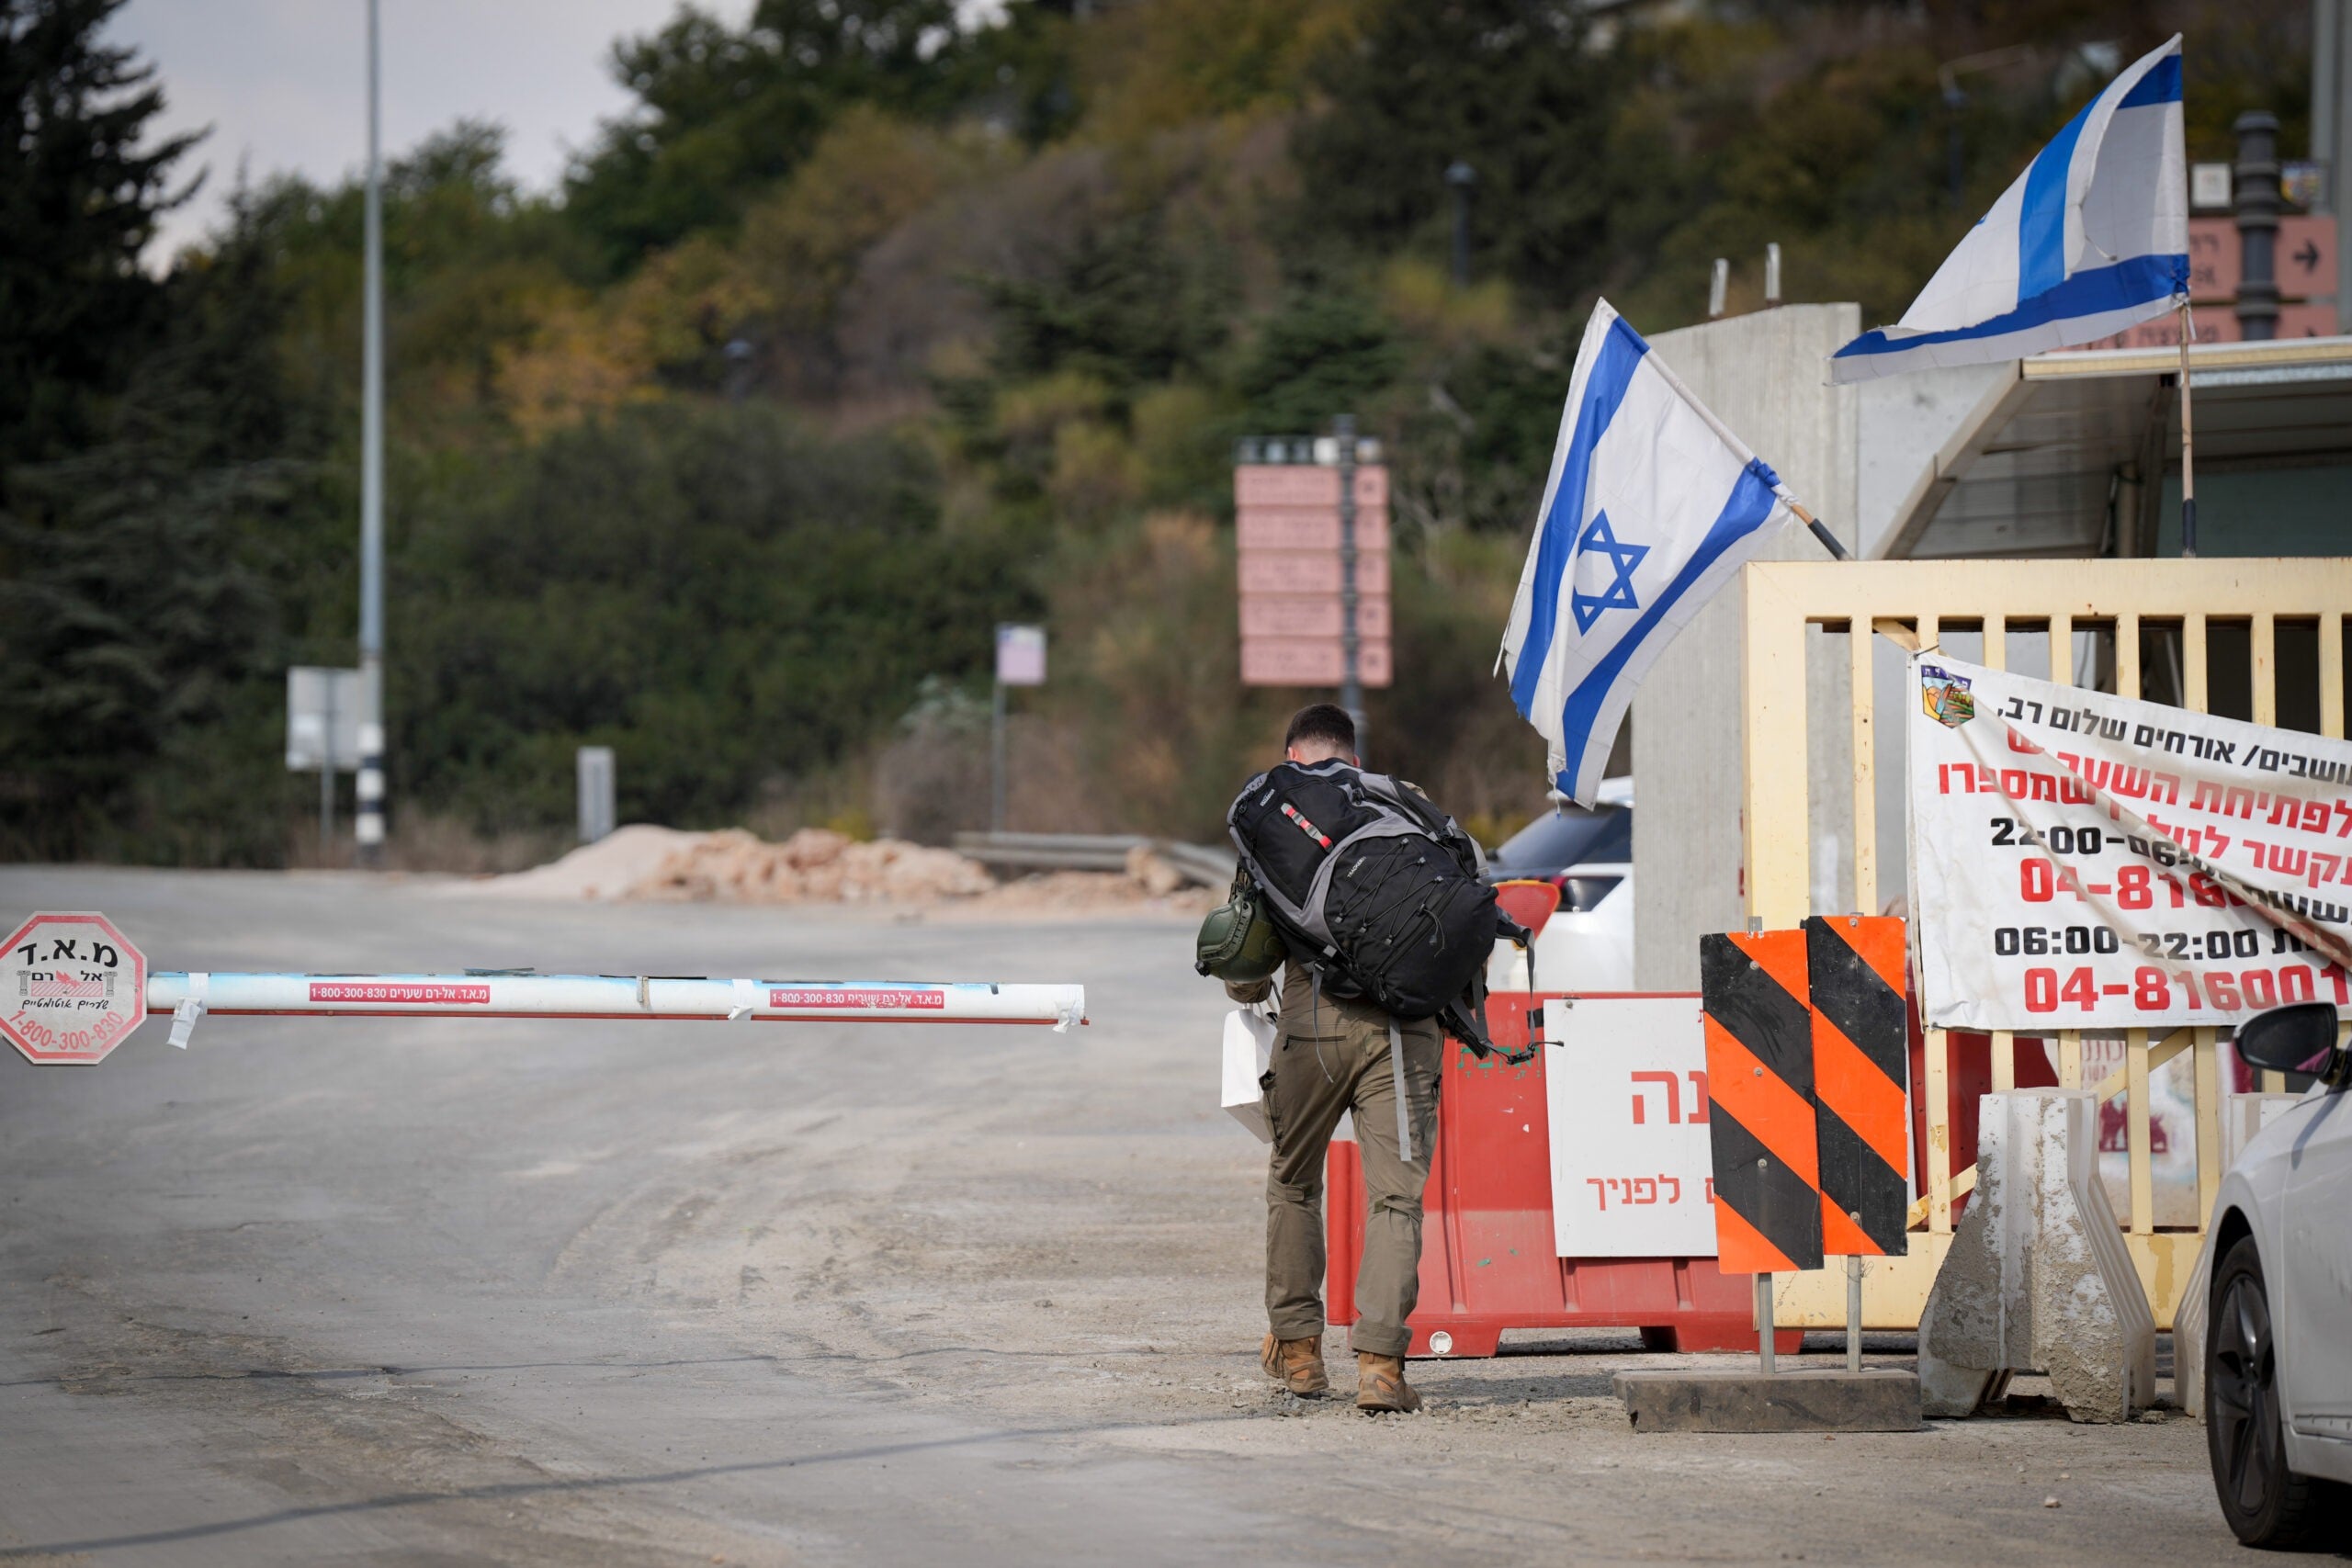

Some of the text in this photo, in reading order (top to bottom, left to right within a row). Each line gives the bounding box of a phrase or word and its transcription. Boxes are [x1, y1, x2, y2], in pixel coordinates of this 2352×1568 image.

[1997, 696, 2043, 724] רב,
[2049, 705, 2127, 741] שלום
[2133, 724, 2236, 764] אורחים
[2188, 780, 2352, 839] לפתיחת
[17, 939, 119, 968] מ.א.ד
[31, 970, 103, 982] אל רם
[77, 998, 109, 1010] שערים
[311, 987, 387, 998] 1-800-300-830
[390, 987, 423, 999] שערים
[425, 987, 456, 999] אל-רם
[772, 992, 844, 1004] 1-800-300-830
[9, 1010, 124, 1050] 1-800-300-830
[1586, 1173, 1680, 1211] לפניך
